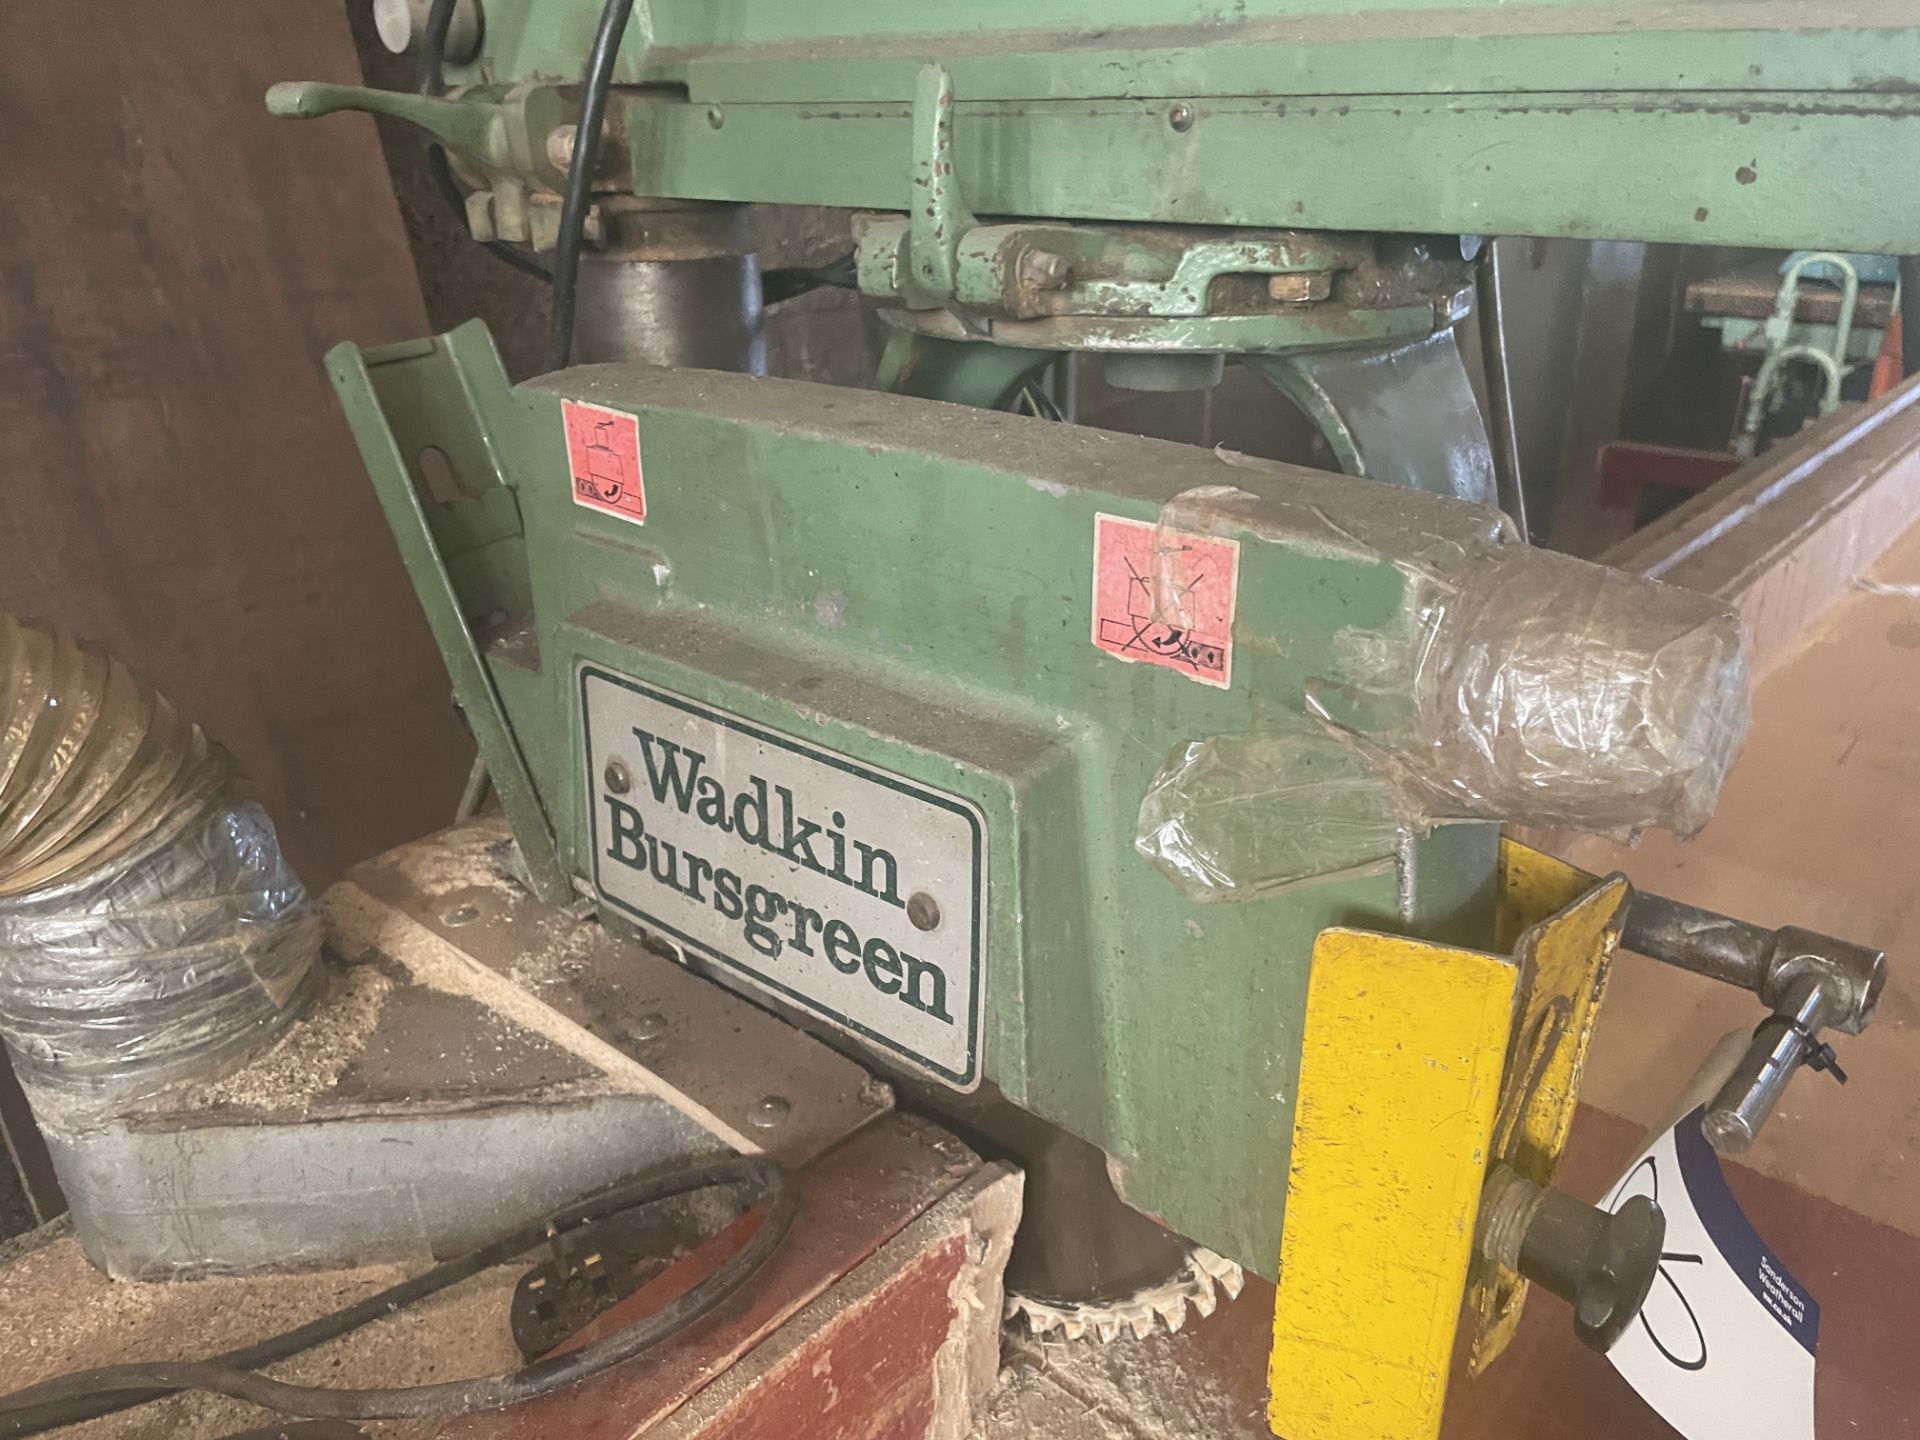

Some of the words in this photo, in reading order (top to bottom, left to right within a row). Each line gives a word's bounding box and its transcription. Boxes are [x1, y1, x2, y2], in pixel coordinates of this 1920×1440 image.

[632, 726, 906, 910] Wadkin
[603, 794, 954, 1025] Bursgreen
[1759, 1268, 1803, 1323] Weatherall
[1761, 1255, 1805, 1311] Sanderson
